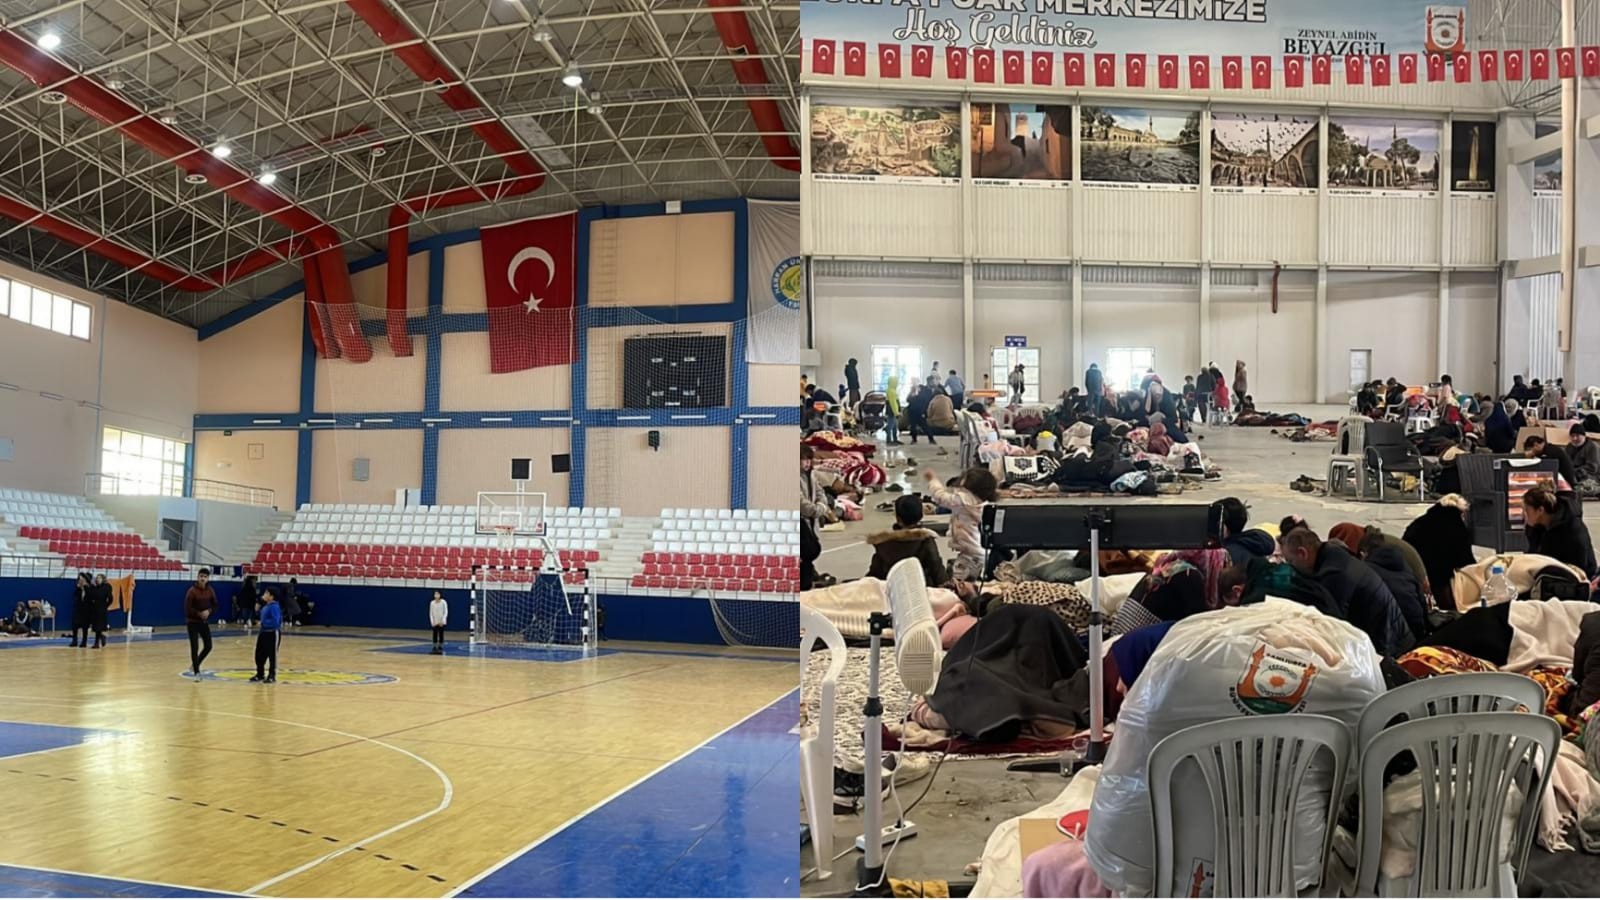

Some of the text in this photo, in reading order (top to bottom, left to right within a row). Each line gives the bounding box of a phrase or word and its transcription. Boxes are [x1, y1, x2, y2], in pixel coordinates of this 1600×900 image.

[967, 11, 1097, 56] Geldiniz
[1298, 29, 1377, 40] ZEYNEL ABİDİN
